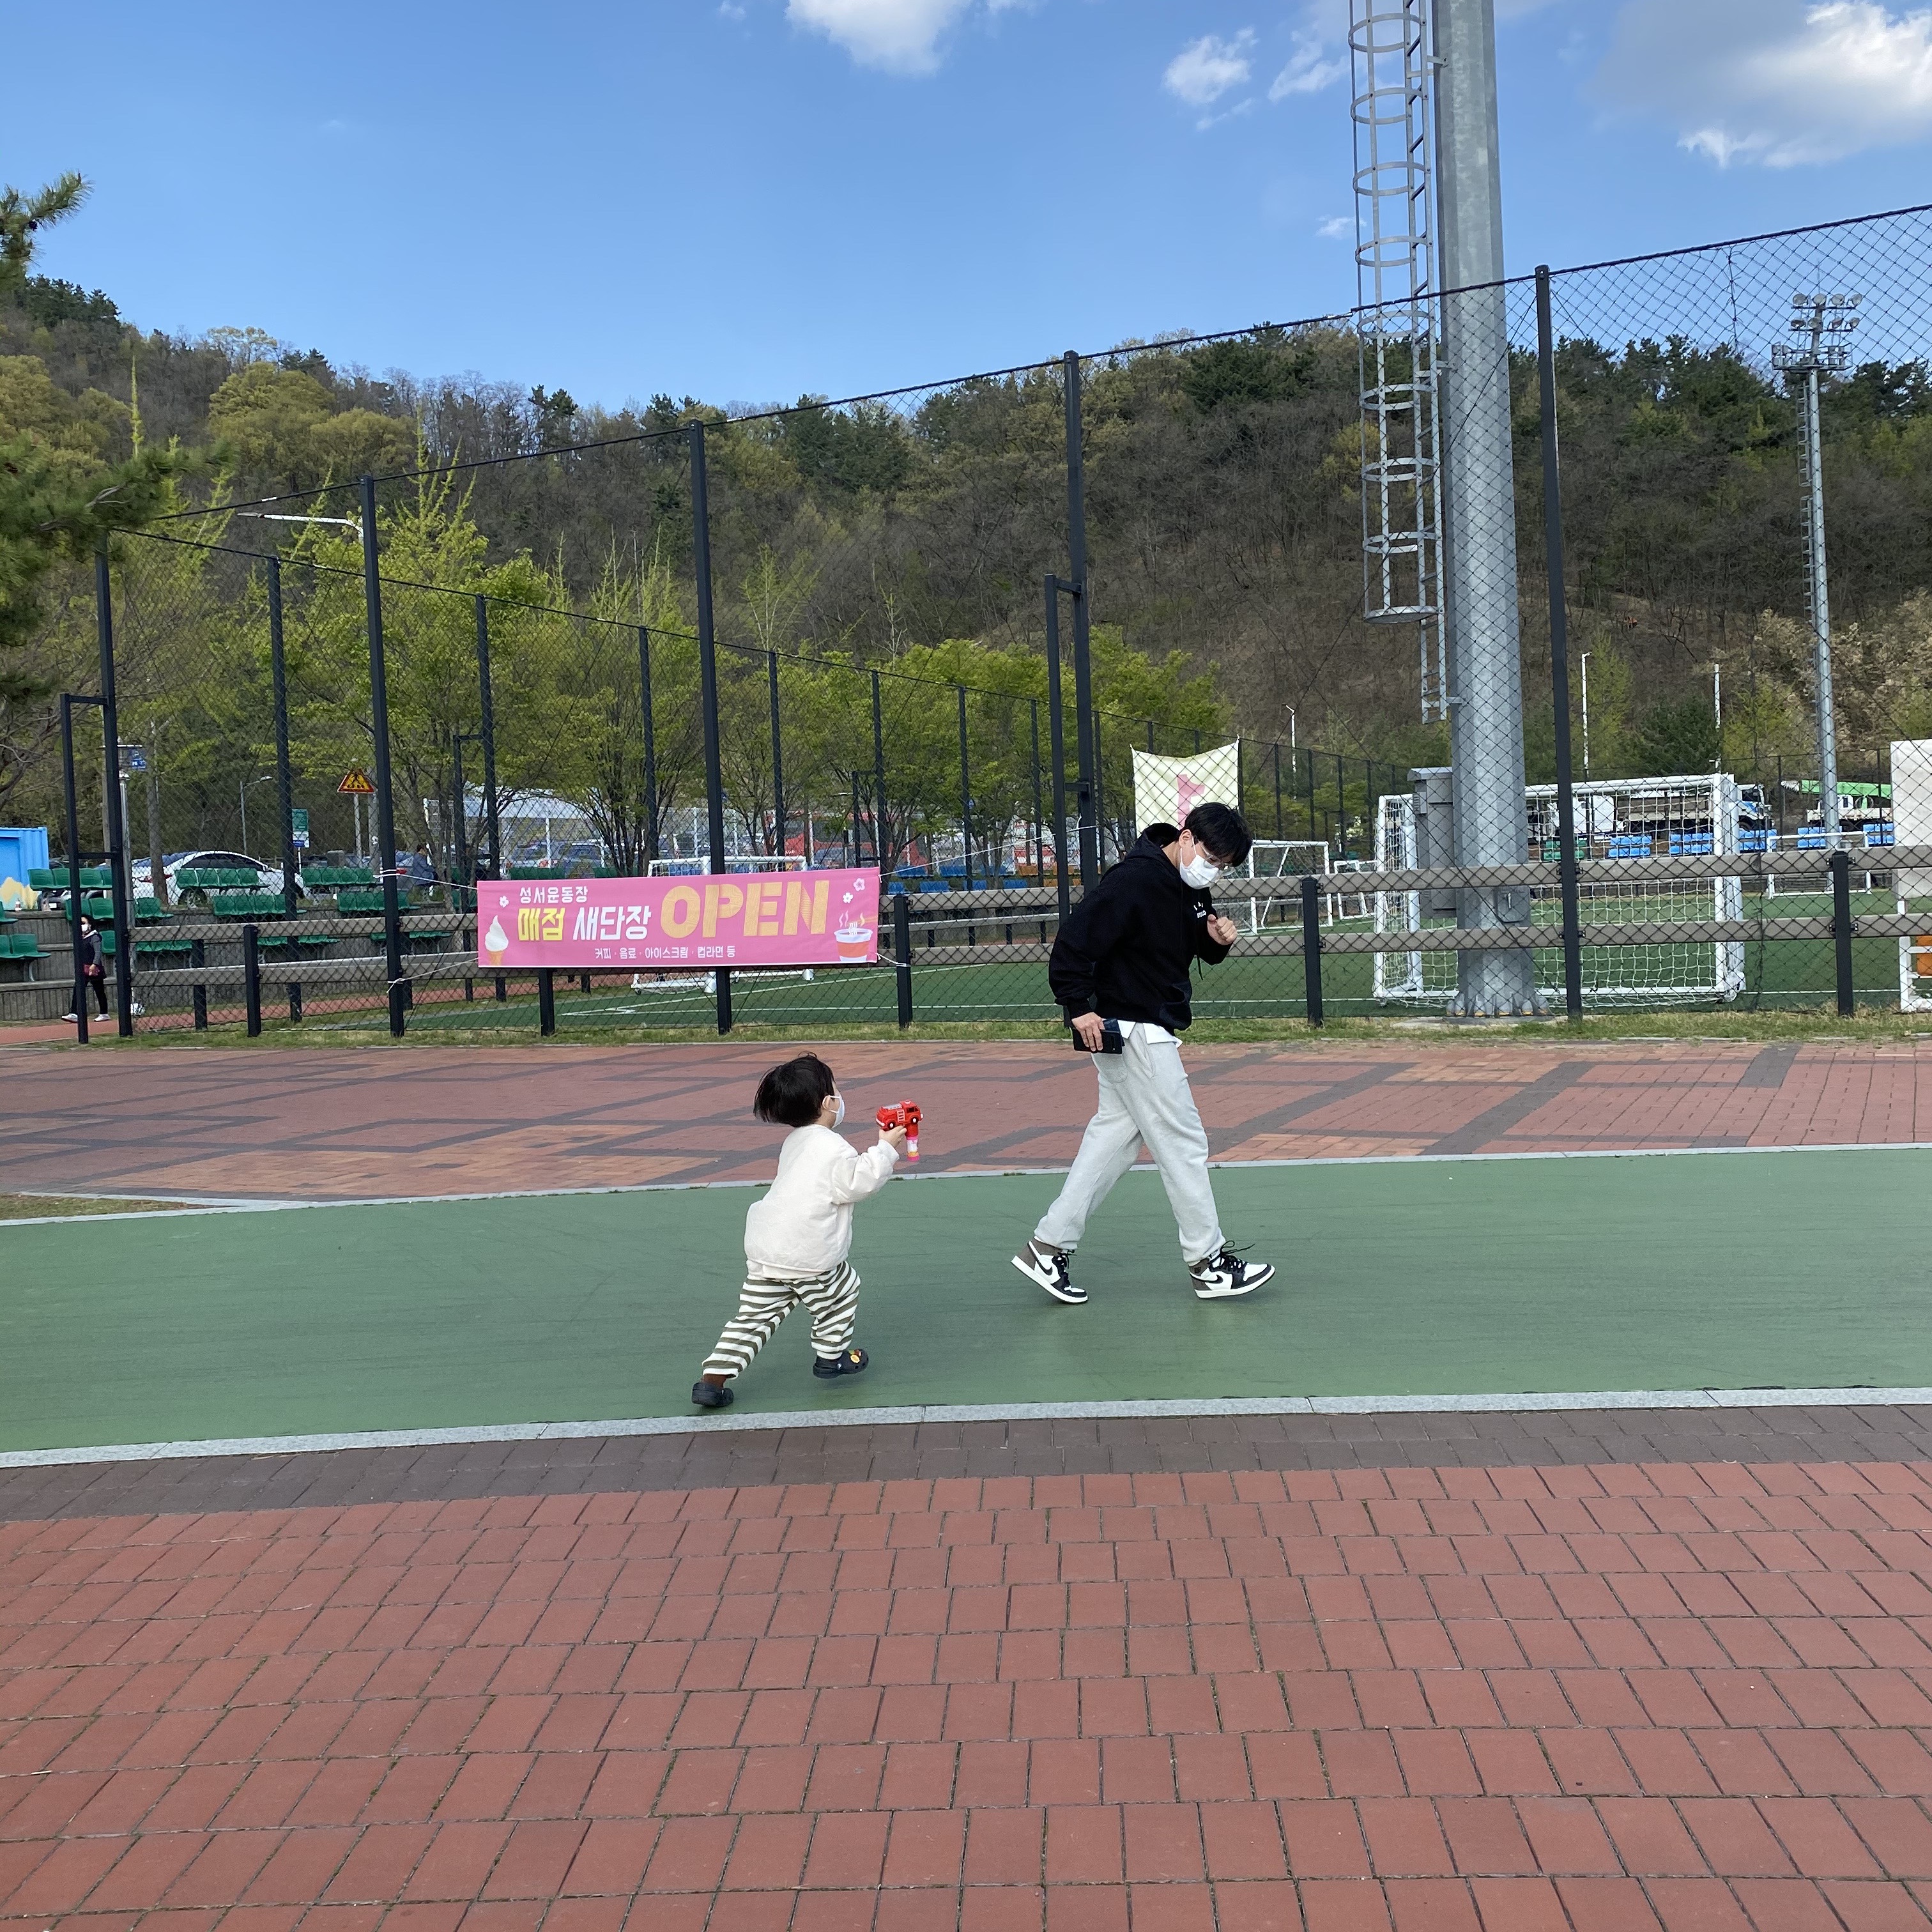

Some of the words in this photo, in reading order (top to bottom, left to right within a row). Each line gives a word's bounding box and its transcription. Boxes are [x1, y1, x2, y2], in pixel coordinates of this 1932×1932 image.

[519, 885, 588, 904] 성서운동장
[518, 907, 565, 941] 매점
[572, 905, 652, 940] 새단장
[660, 880, 830, 939] OPEN
[594, 947, 611, 959] 커피
[619, 947, 637, 959] 음료
[645, 946, 689, 959] 아이스크림
[697, 946, 723, 958] 컵라면
[726, 946, 735, 958] 등
